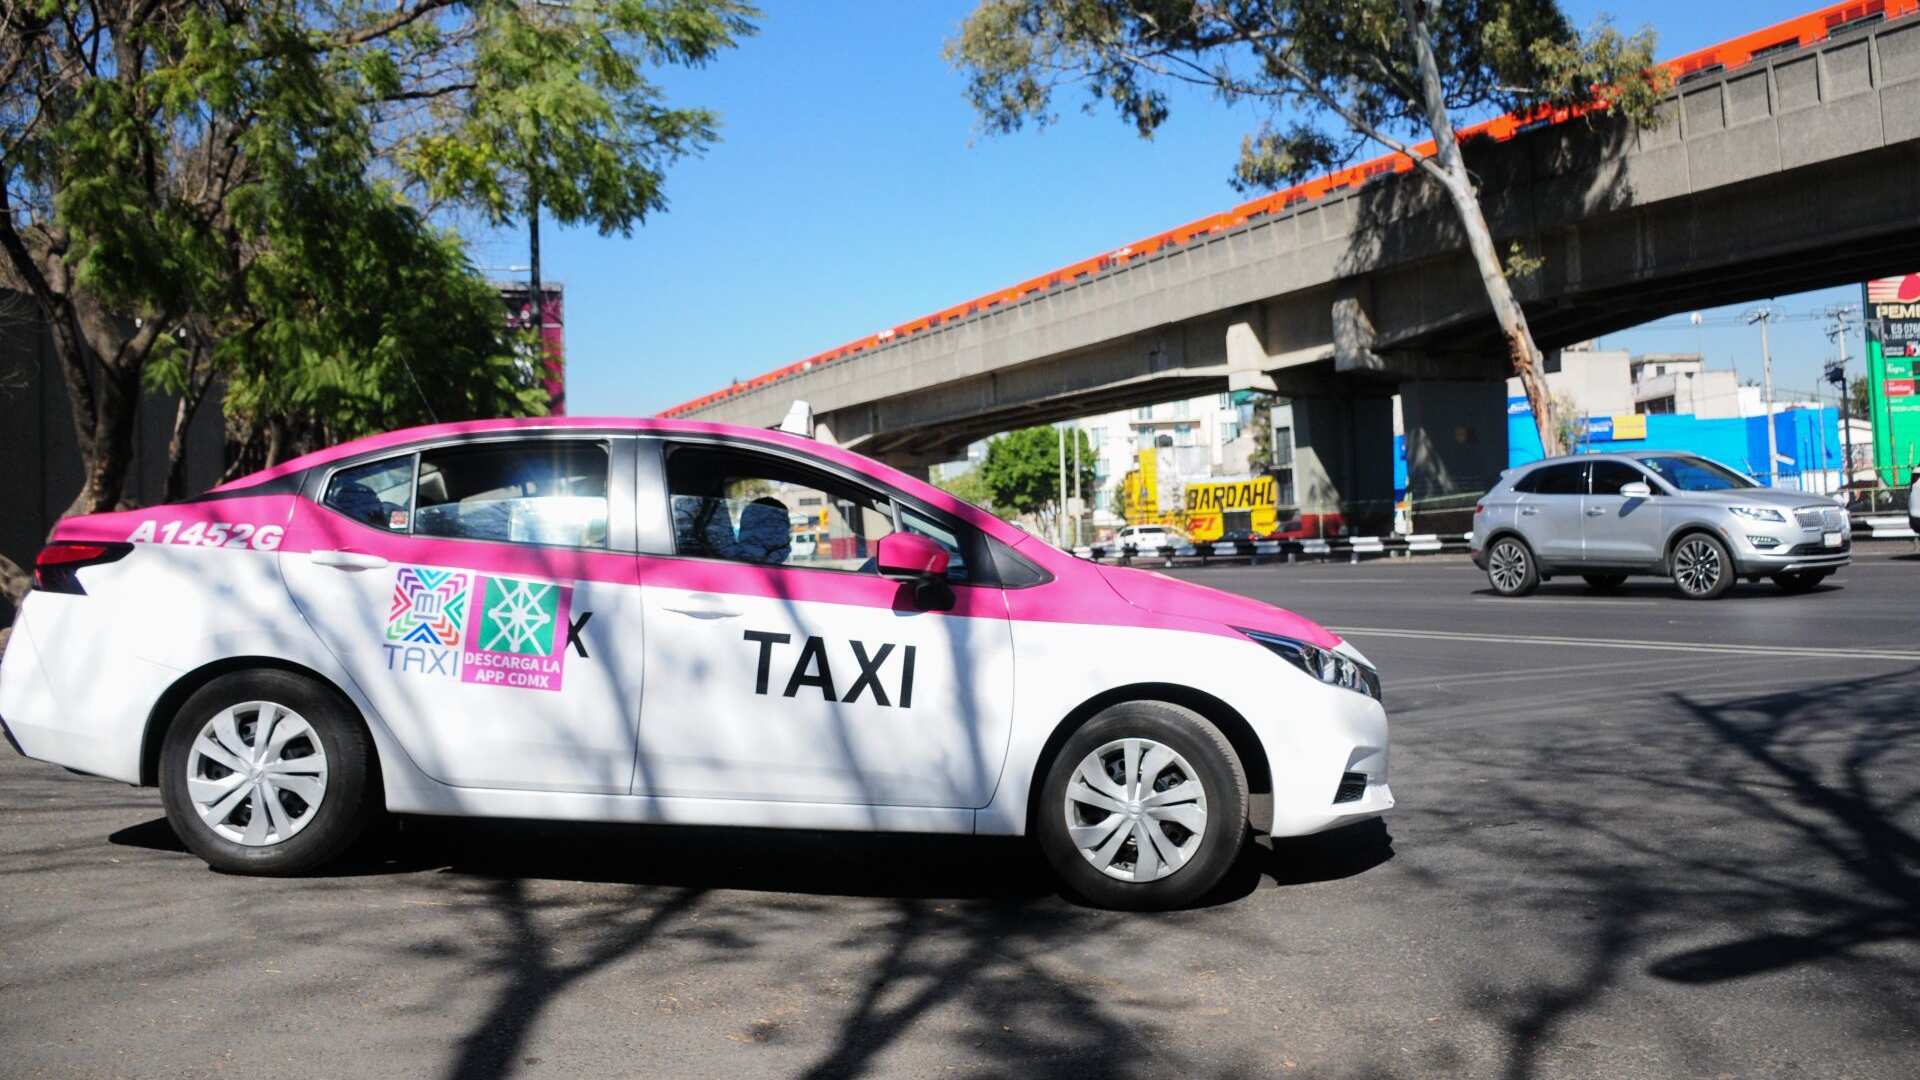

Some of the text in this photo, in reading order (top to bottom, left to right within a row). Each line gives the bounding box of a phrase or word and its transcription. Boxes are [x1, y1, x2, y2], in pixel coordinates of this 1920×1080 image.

[1186, 480, 1275, 510] BARDAHL
[126, 520, 285, 551] A1452G
[382, 643, 460, 677] TAXI
[464, 652, 561, 673] DESCARGA LA
[743, 629, 917, 709] TAXI
[475, 668, 550, 688] APP CDMX
